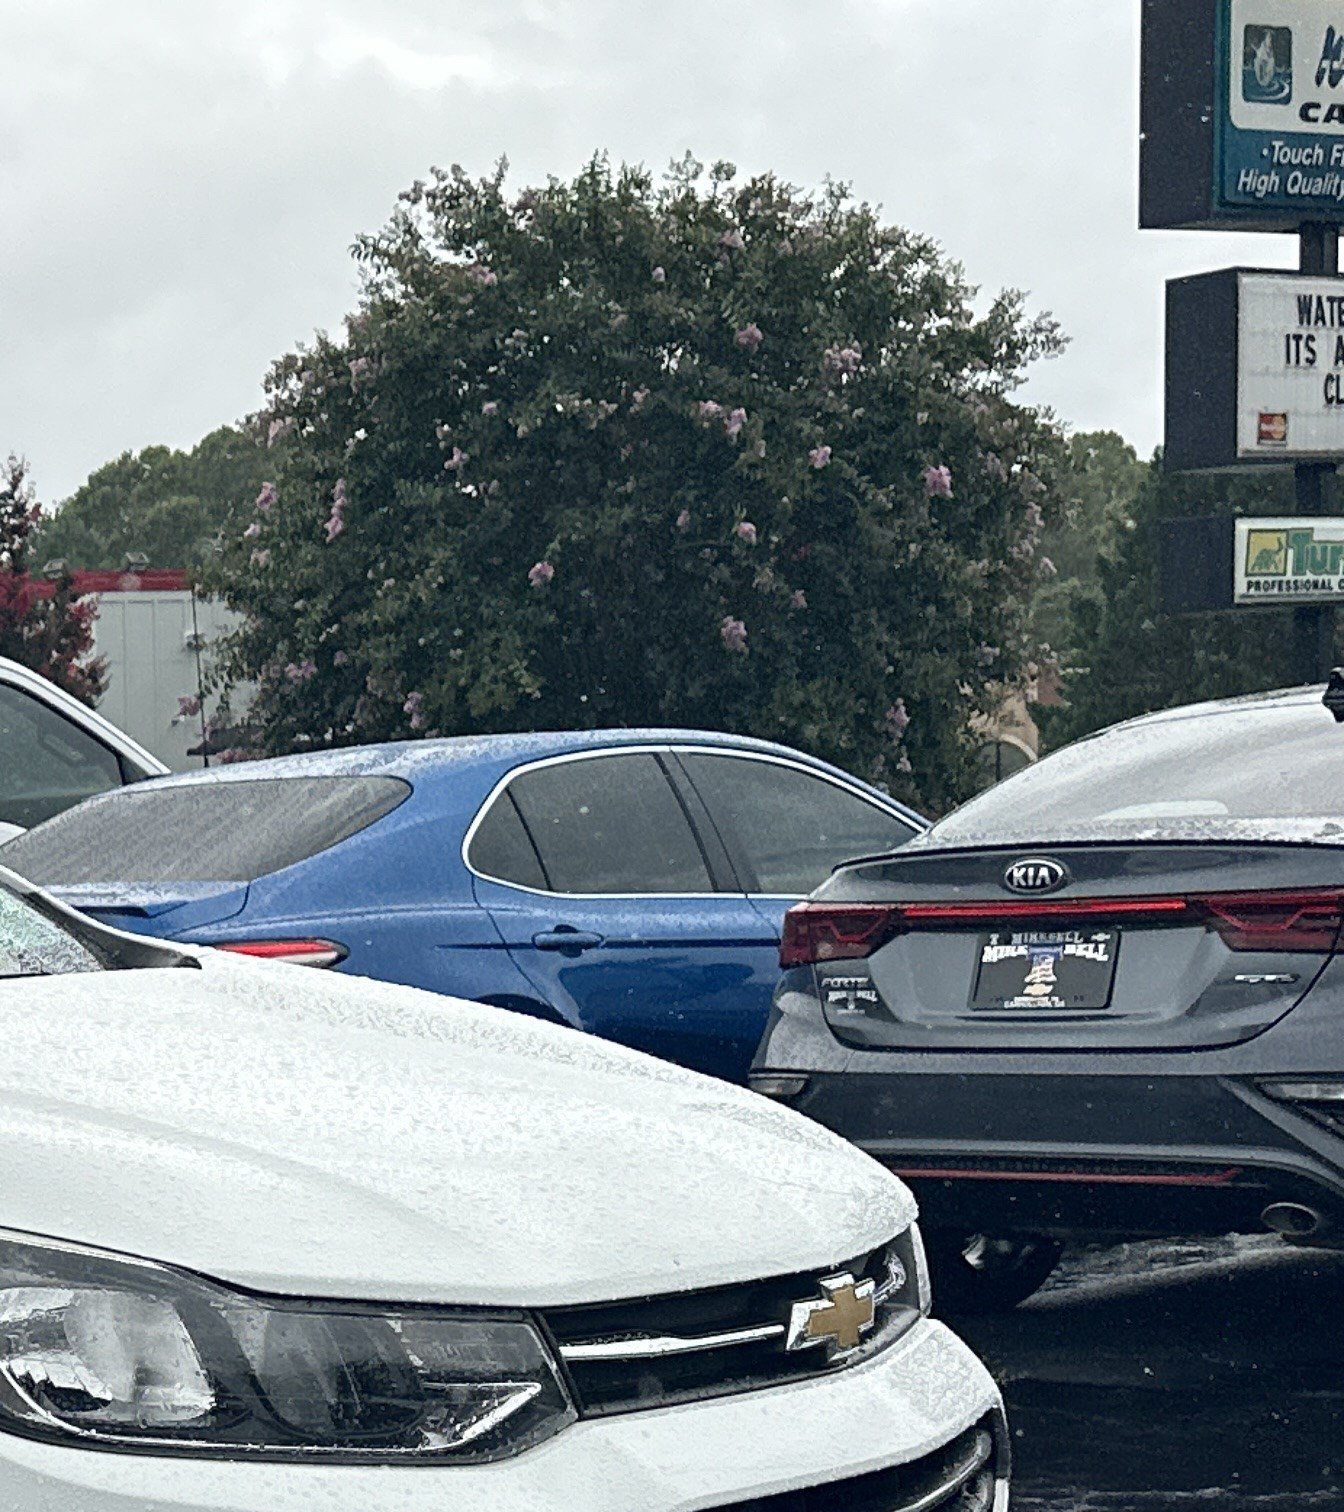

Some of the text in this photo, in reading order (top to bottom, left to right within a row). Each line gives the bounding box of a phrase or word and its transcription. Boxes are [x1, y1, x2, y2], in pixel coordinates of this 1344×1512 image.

[1272, 140, 1324, 166] Touch
[1237, 168, 1280, 198] High
[1286, 333, 1317, 366] ITS
[1324, 373, 1344, 405] CL
[1246, 578, 1333, 593] PROFESSIONAL
[1012, 866, 1052, 887] KIA
